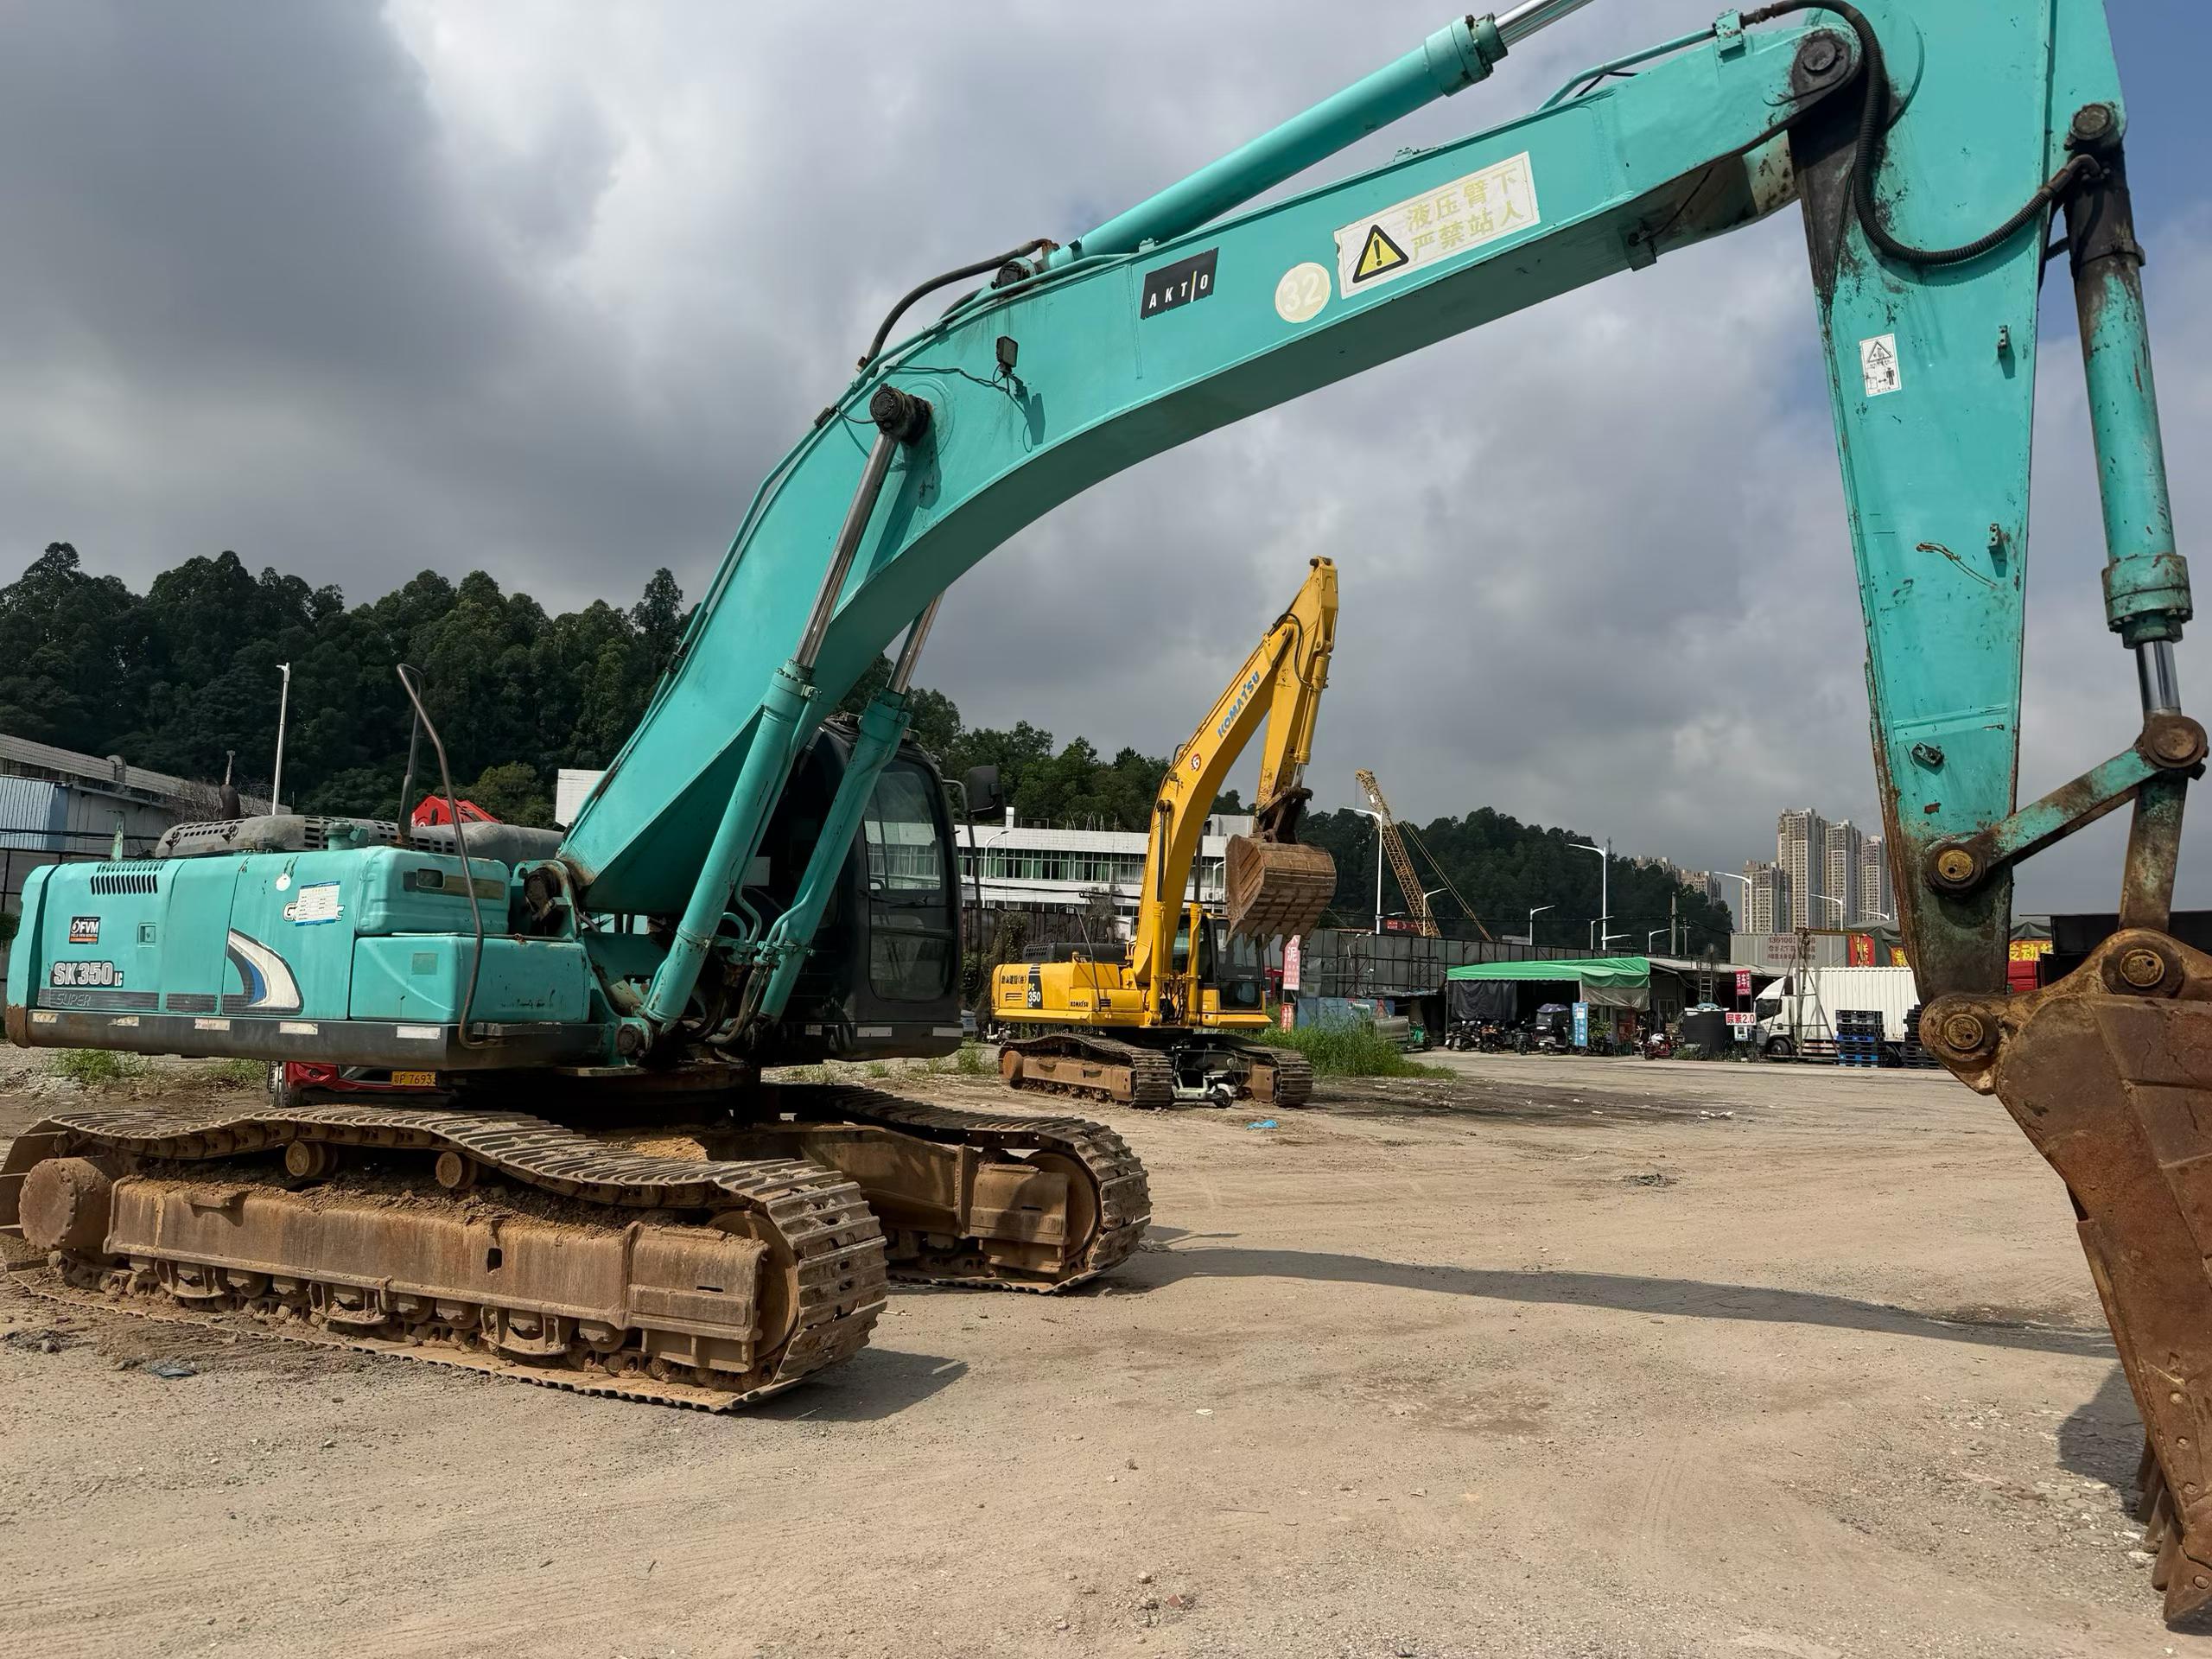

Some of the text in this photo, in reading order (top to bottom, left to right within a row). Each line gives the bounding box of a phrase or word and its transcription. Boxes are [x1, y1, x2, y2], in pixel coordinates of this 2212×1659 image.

[1406, 168, 1517, 232] 液压臂下
[1411, 200, 1524, 261] 严禁站人
[1283, 272, 1323, 312] 32
[1217, 671, 1261, 738] KOMATSU
[57, 993, 91, 1006] SUPER
[1028, 991, 1041, 1001] 350
[1726, 1014, 1755, 1024] 尿素2.0
[410, 1073, 435, 1084] 7693
